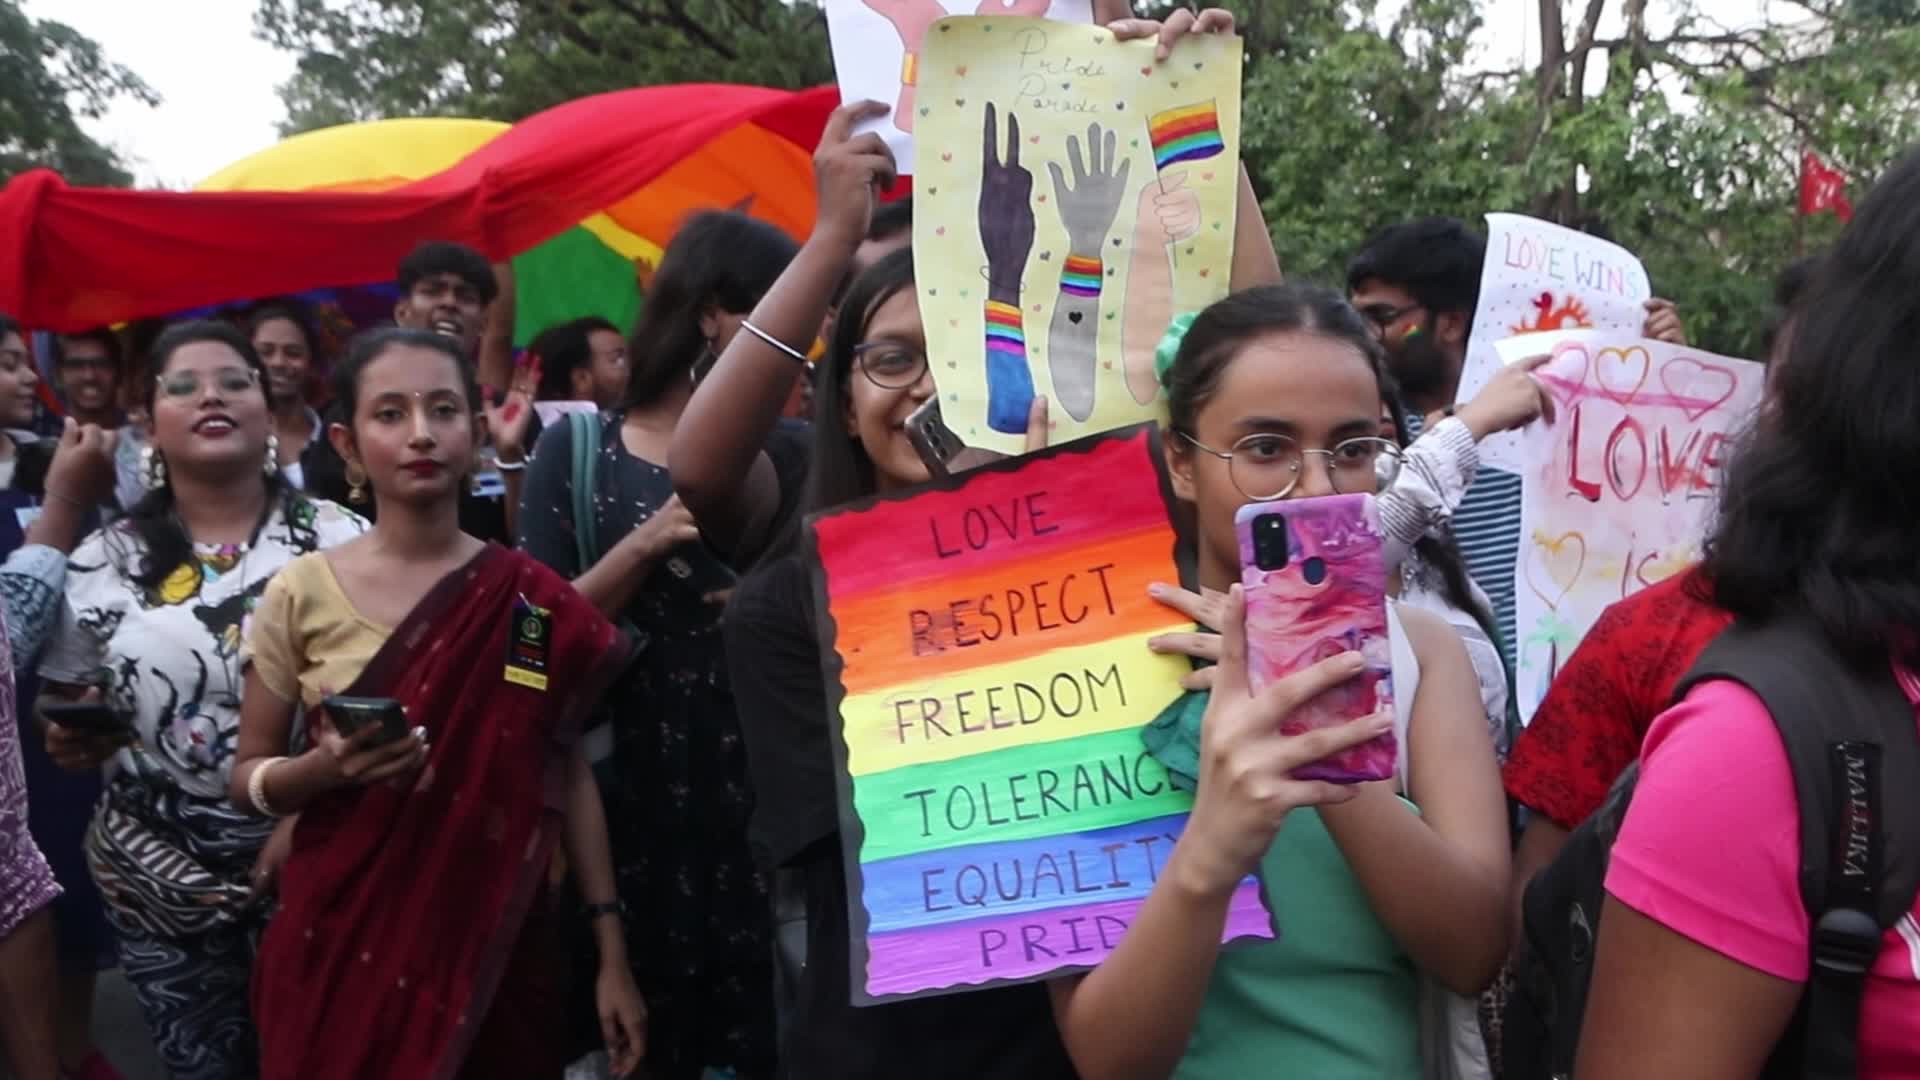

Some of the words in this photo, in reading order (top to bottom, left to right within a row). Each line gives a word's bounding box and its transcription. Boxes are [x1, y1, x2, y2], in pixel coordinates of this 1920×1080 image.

[1015, 26, 1104, 77] Pride
[1016, 73, 1101, 112] Parade
[1504, 231, 1564, 280] LOVE
[1574, 252, 1637, 298] WINS
[1567, 403, 1732, 505] LOVE
[930, 491, 1060, 559] LOVE
[908, 565, 1116, 658] RESPECT
[894, 663, 1127, 745] FREEDOM
[1843, 754, 1869, 876] MALLIKA
[923, 832, 1178, 912] EQUALIT
[978, 915, 1128, 968] PRID
